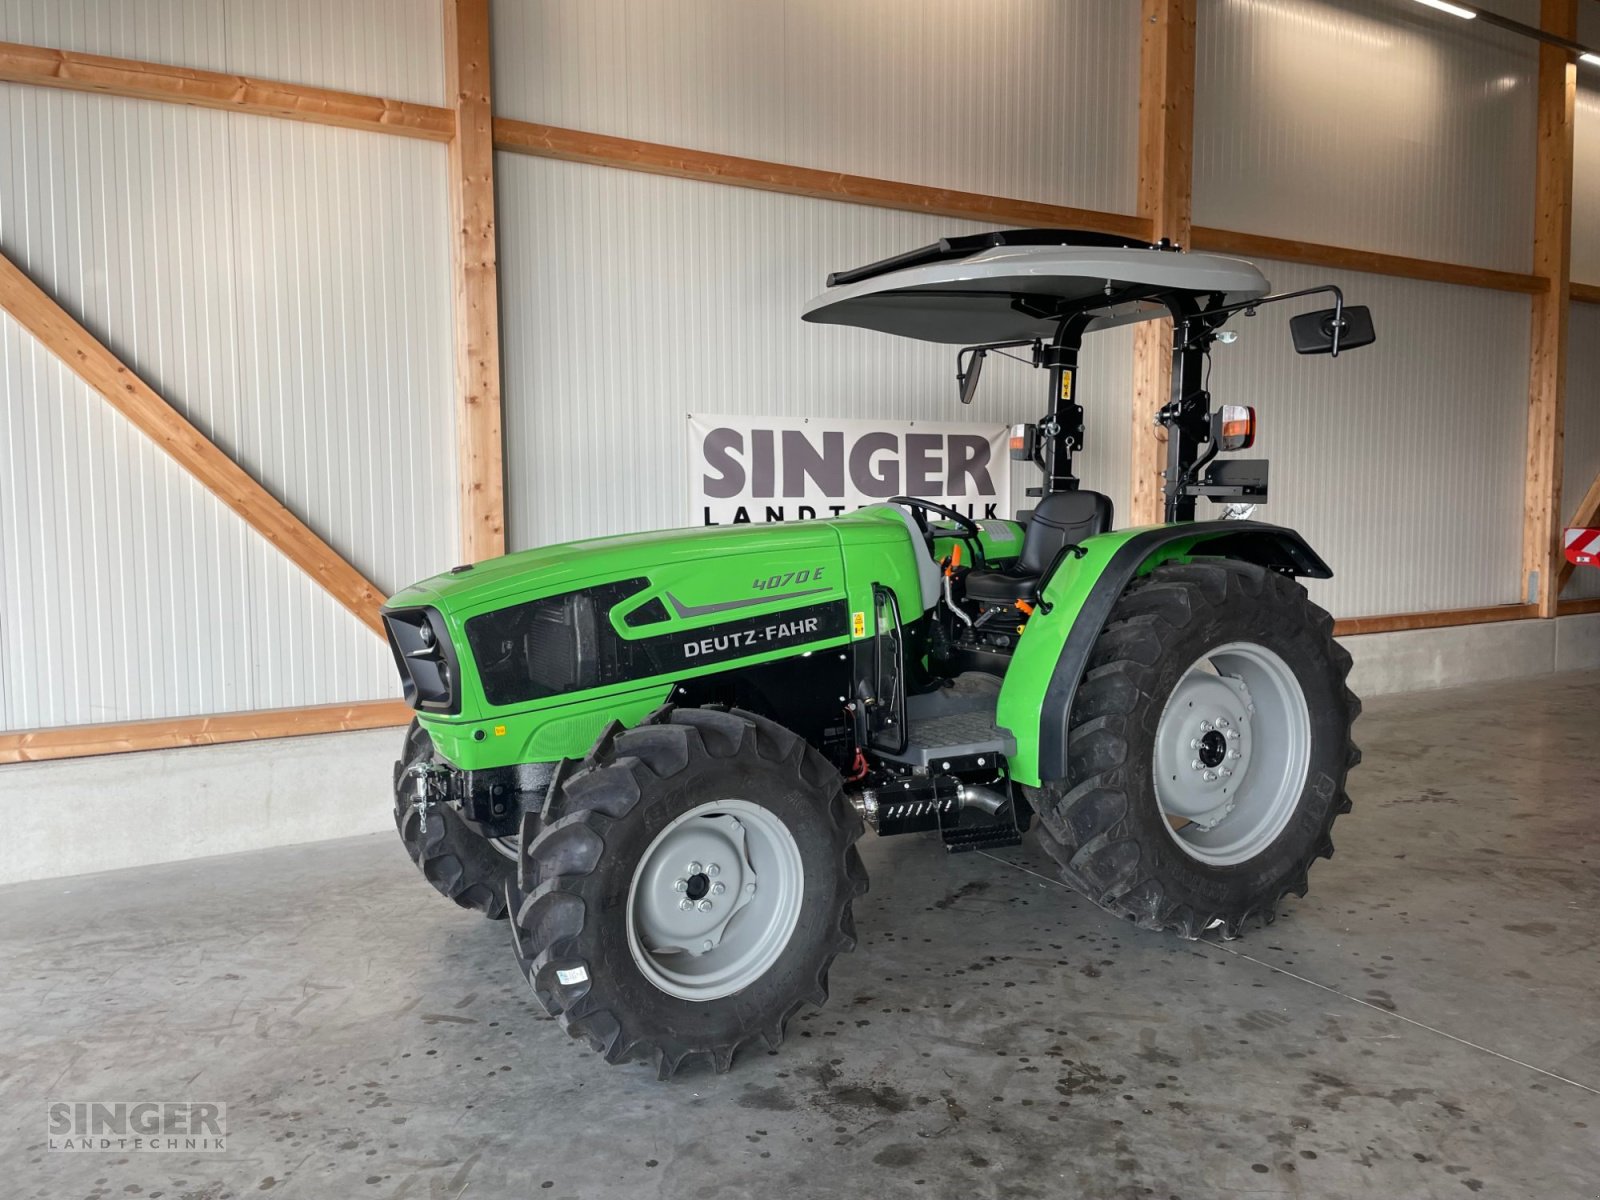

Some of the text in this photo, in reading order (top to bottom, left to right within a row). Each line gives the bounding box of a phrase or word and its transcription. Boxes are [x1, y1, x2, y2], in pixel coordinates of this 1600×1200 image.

[703, 427, 996, 499] SINGER
[704, 503, 998, 526] LANDTIK
[752, 566, 825, 591] 4070 E
[683, 617, 818, 658] DEUTZ-FAHR
